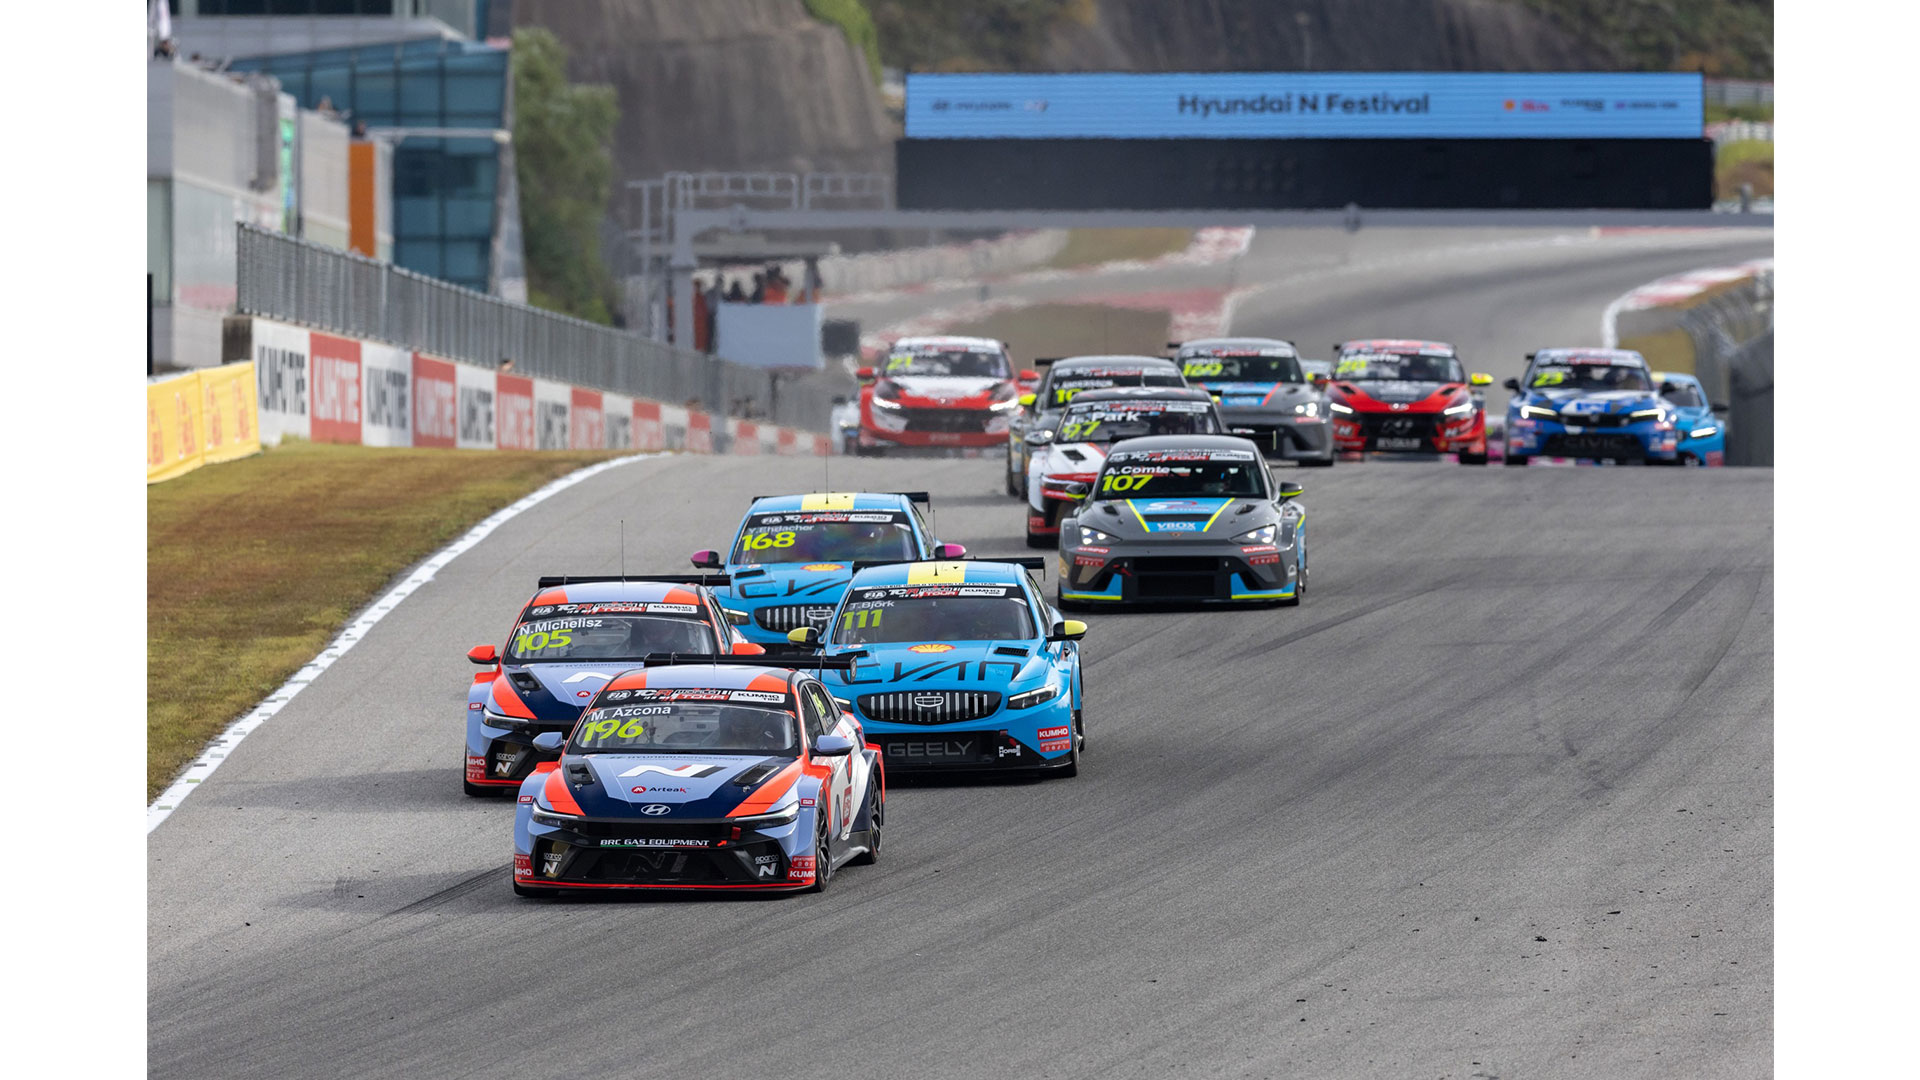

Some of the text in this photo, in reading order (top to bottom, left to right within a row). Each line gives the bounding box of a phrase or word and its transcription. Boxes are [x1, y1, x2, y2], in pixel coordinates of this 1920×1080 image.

[1178, 92, 1429, 118] Hyundai N Festival
[1062, 421, 1101, 439] 97
[1102, 475, 1153, 491] 107
[742, 532, 796, 551] 168
[864, 590, 885, 599] FIA
[532, 605, 552, 616] FIA
[520, 618, 603, 636] N.Michelisz
[842, 609, 883, 630] 111
[515, 629, 573, 654] 105
[607, 689, 674, 700] FIA TCR
[591, 706, 671, 721] M. Azcona
[583, 718, 643, 742] 196
[1039, 728, 1068, 738] KUMHO
[887, 740, 973, 757] GEELY
[649, 839, 710, 847] EQUIPMENT
[755, 855, 779, 864] sparco
[515, 868, 533, 876] MHO
